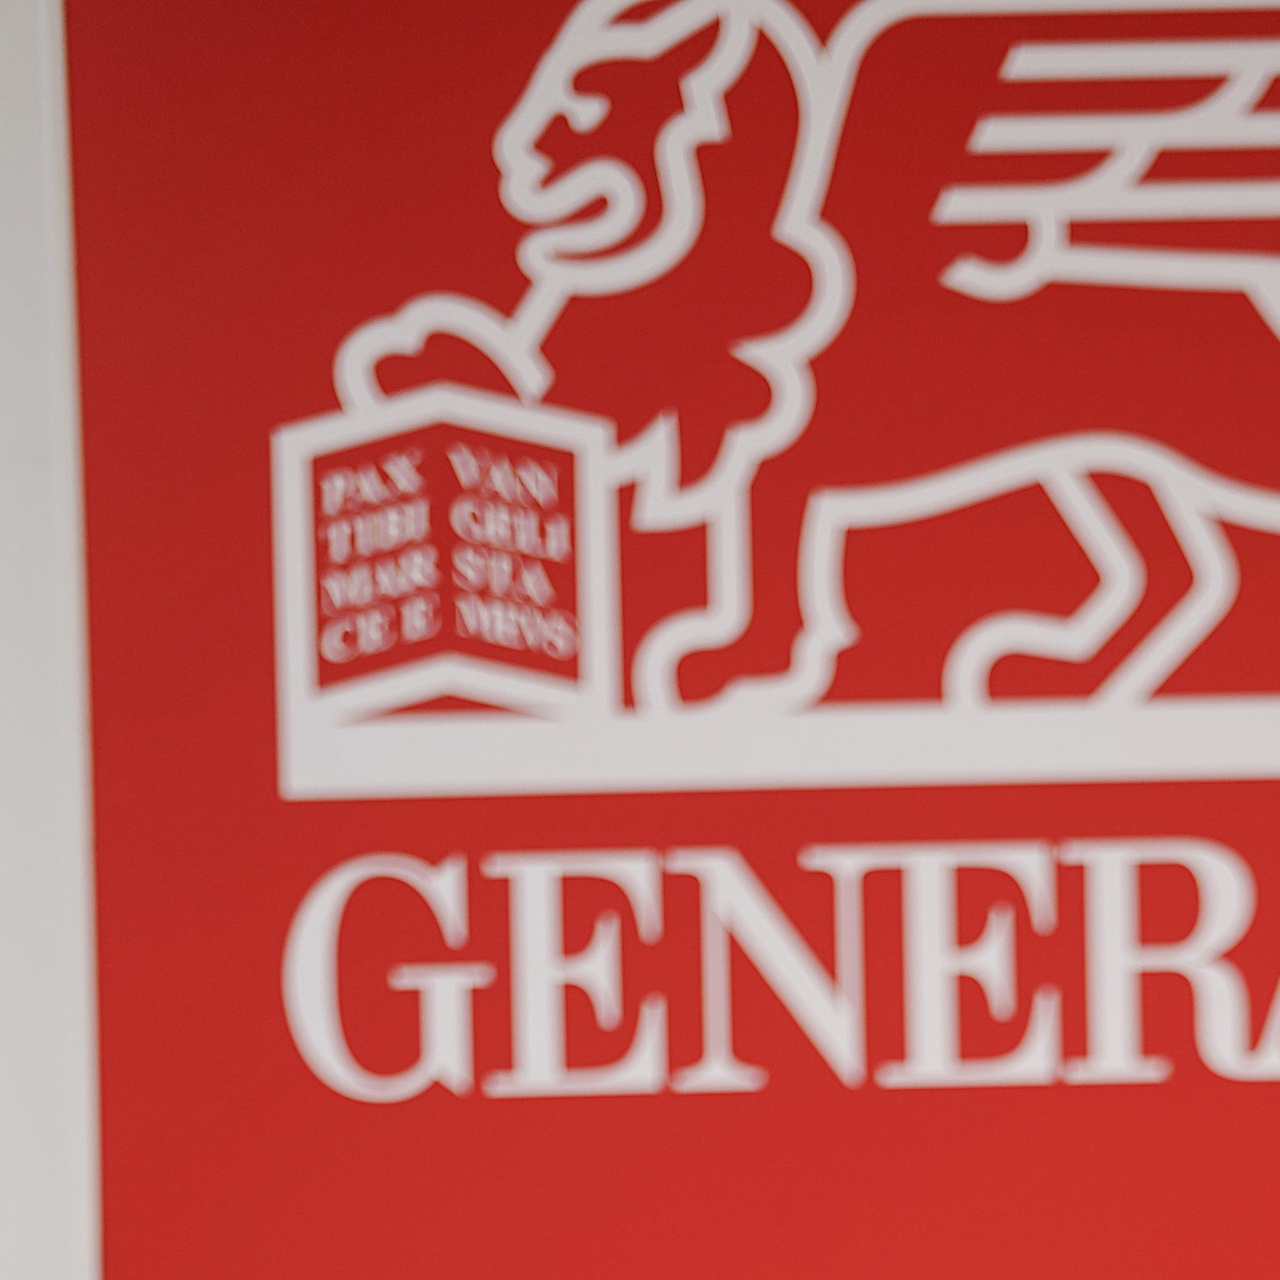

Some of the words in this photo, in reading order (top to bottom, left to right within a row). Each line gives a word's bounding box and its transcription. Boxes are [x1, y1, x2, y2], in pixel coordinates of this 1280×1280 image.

[321, 448, 424, 516] PAX
[446, 442, 560, 509] VAN
[321, 545, 441, 616] MAR
[452, 543, 556, 607] STA
[320, 604, 397, 663] CE
[401, 591, 442, 646] E
